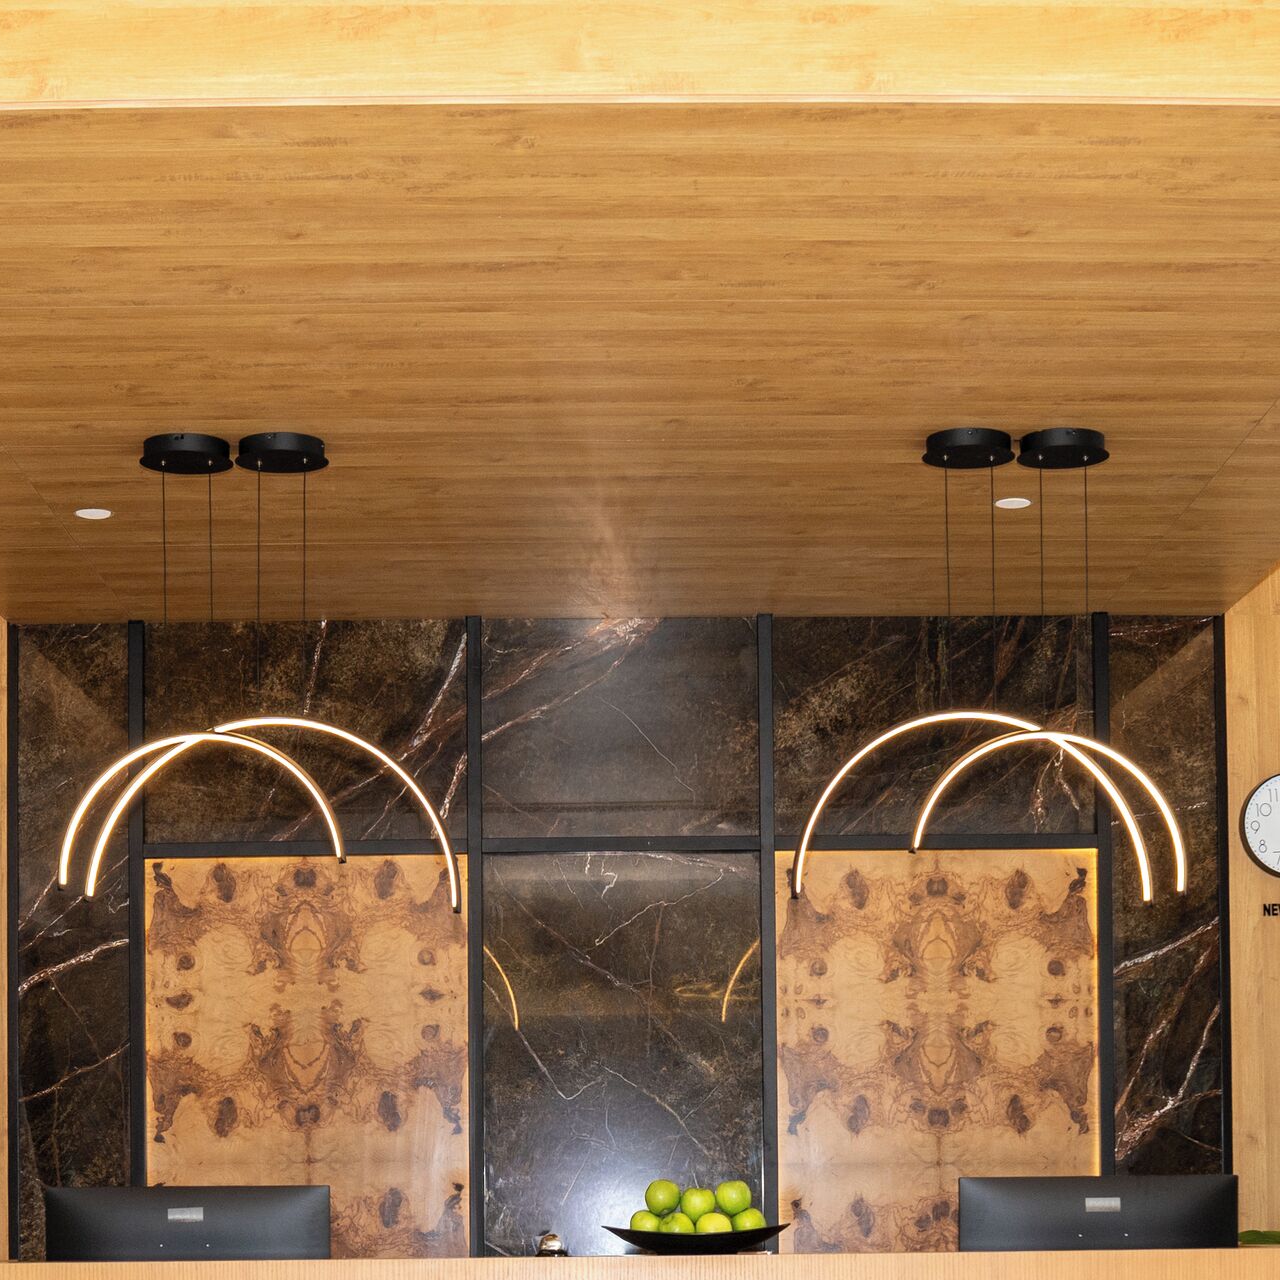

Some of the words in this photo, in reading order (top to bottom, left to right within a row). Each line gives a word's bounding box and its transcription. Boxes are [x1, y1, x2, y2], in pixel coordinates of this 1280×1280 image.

[1268, 788, 1278, 802] 11
[1256, 803, 1272, 817] 10
[1251, 820, 1260, 834] 9
[1259, 839, 1267, 853] 8
